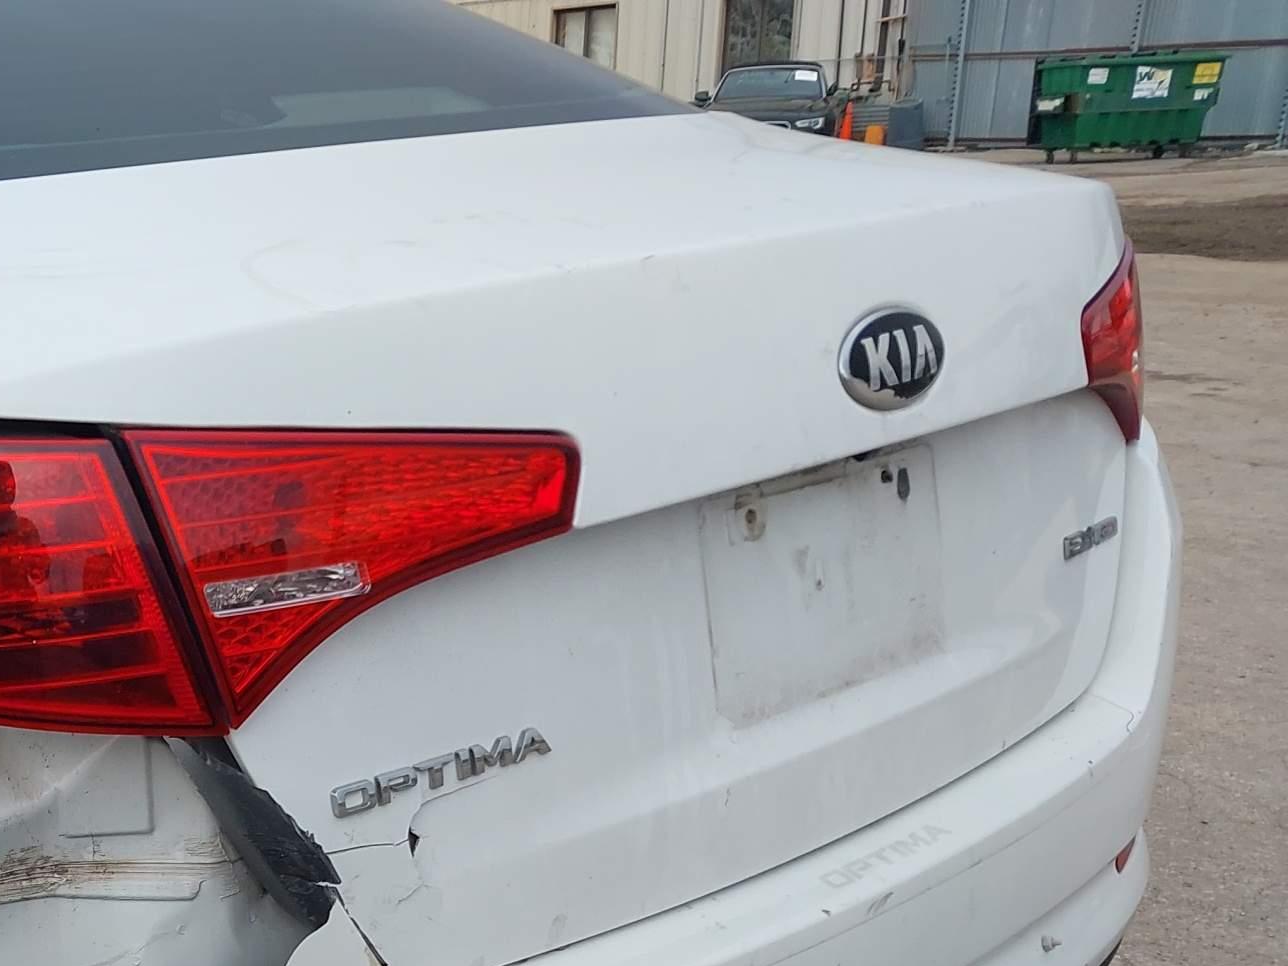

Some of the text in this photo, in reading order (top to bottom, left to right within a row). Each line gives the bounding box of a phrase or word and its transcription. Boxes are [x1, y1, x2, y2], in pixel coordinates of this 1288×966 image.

[860, 323, 939, 391] KIA
[329, 726, 553, 819] OPTIMA
[819, 824, 953, 889] OPTIMA
